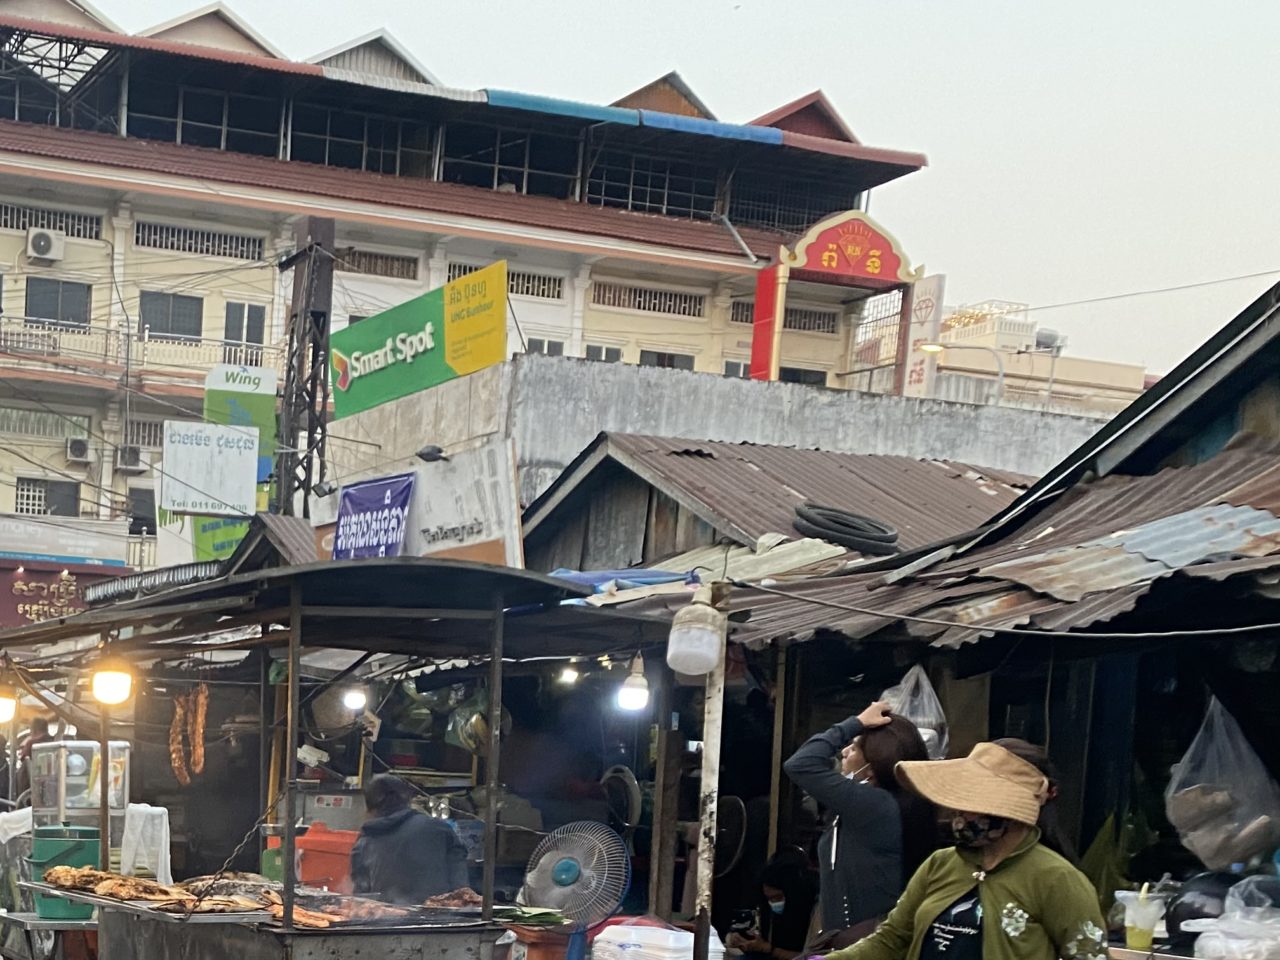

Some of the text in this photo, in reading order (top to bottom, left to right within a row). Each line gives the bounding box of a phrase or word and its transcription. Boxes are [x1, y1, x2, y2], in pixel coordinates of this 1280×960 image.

[351, 337, 396, 378] Smart
[396, 321, 436, 363] Spot
[225, 371, 261, 391] Wing
[191, 501, 209, 509] 011
